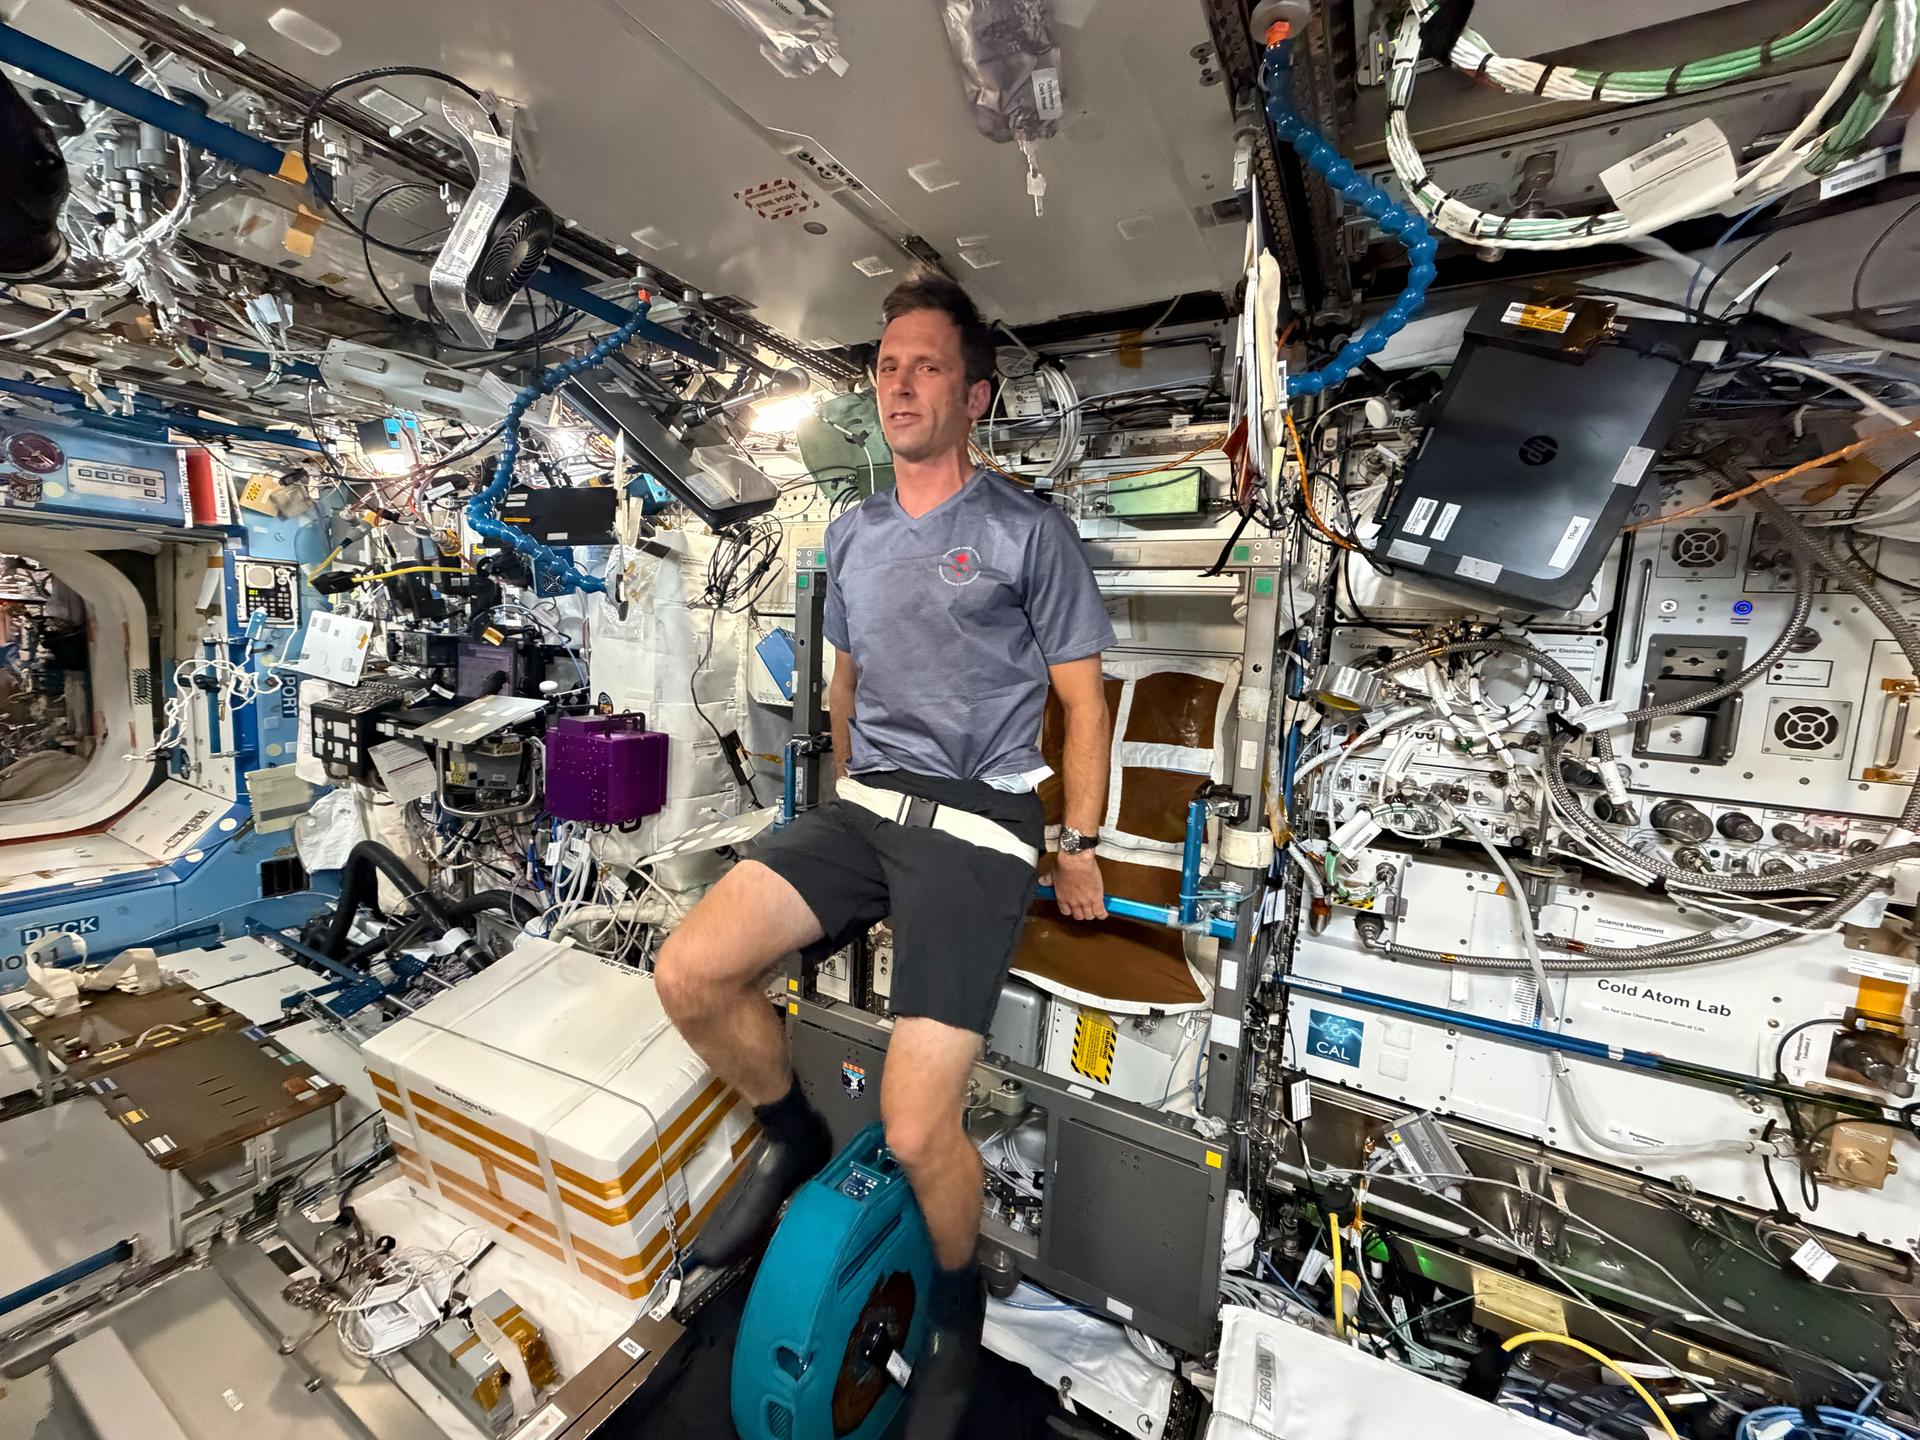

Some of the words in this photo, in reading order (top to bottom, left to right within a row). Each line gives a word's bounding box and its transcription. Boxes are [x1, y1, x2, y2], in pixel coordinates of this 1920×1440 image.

[775, 192, 799, 203] PORT
[282, 676, 298, 718] PORT
[1597, 917, 1625, 928] Science
[1625, 922, 1665, 935] Instrument
[1597, 978, 1638, 997] Cold
[1642, 988, 1690, 1009] Atom
[1696, 999, 1732, 1018] Lab
[1102, 1029, 1111, 1060] WARNING
[1316, 1041, 1351, 1061] CAL
[1259, 1377, 1273, 1412] ZERO
